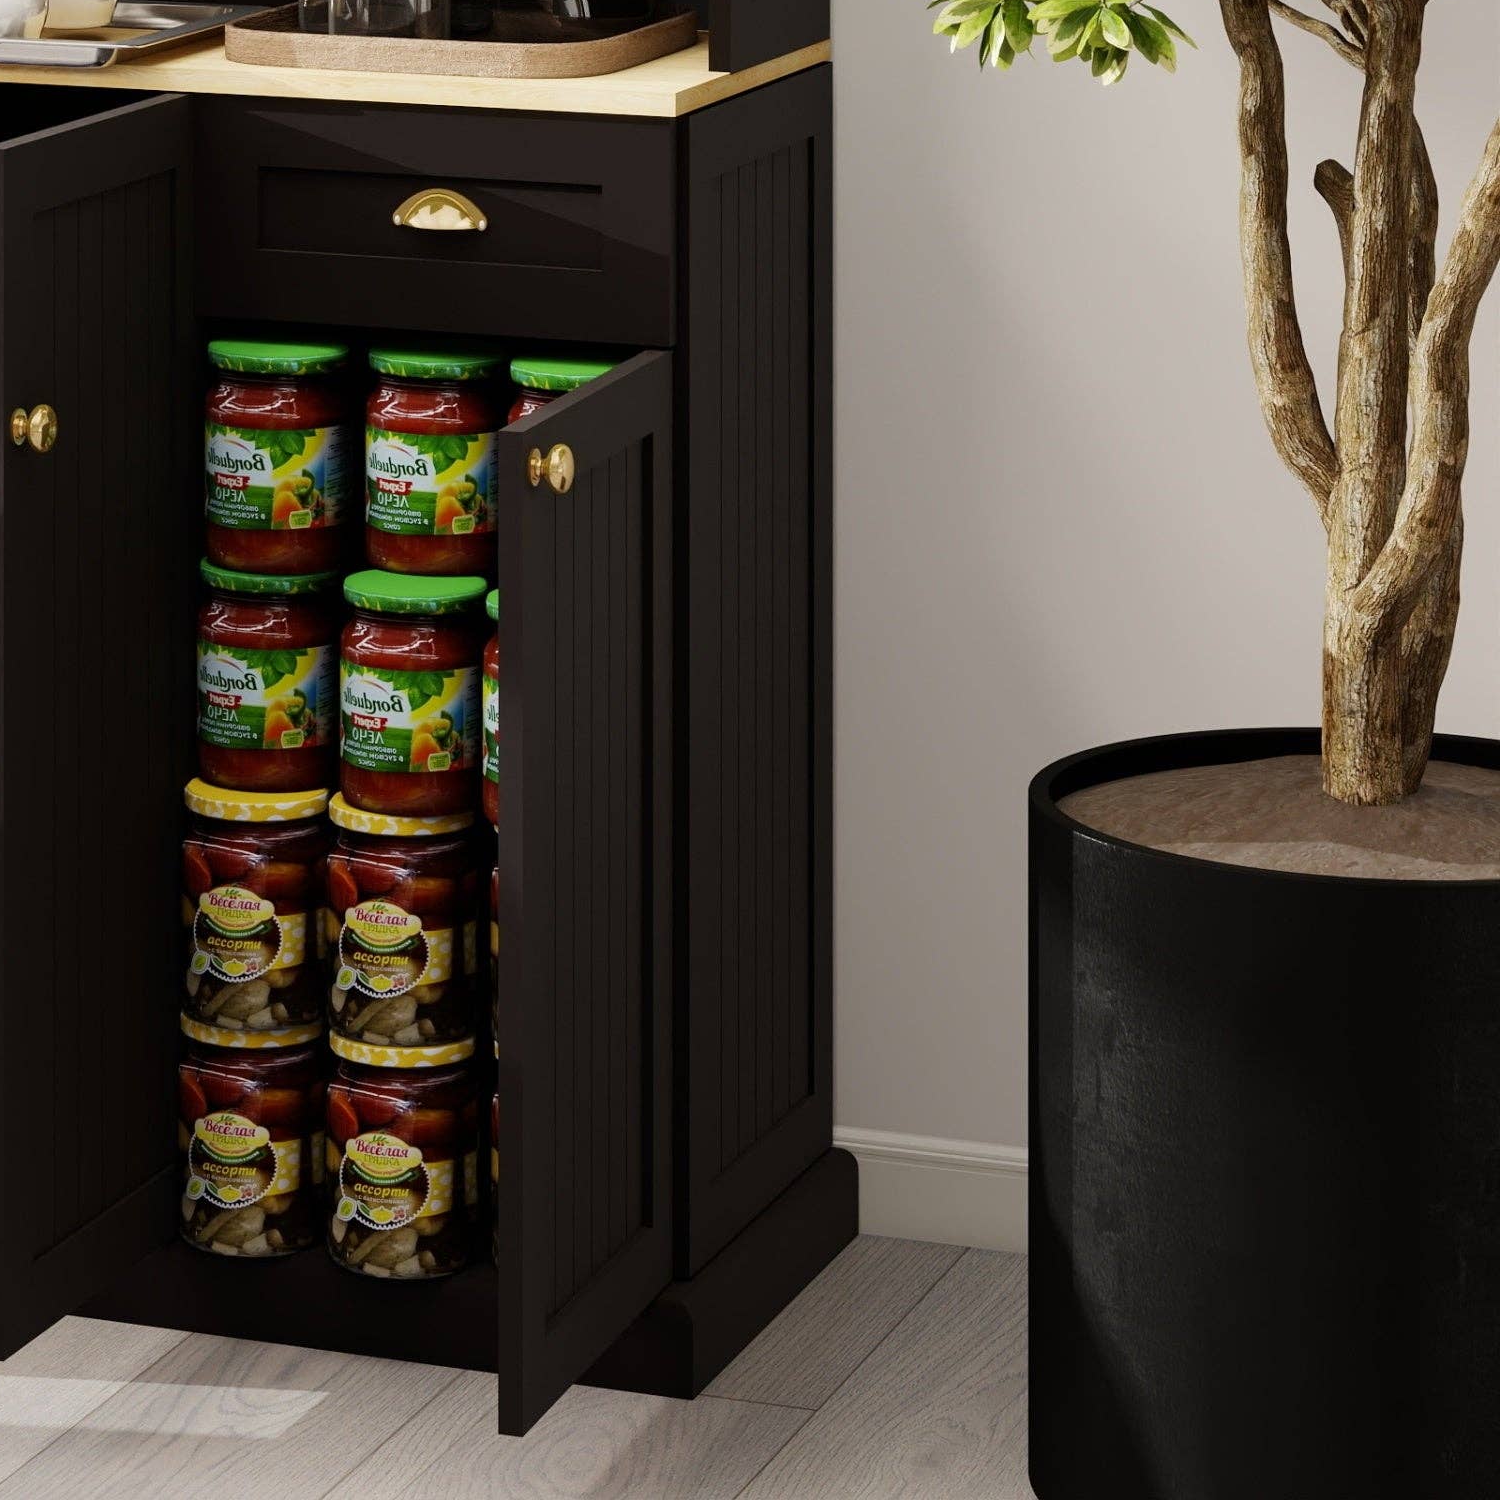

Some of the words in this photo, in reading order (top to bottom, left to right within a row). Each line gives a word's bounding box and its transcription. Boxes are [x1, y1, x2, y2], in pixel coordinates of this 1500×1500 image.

[207, 936, 262, 951] ассорти
[353, 951, 409, 966] ассорти
[202, 1162, 257, 1177] ассорти
[354, 1183, 410, 1198] ассорти
